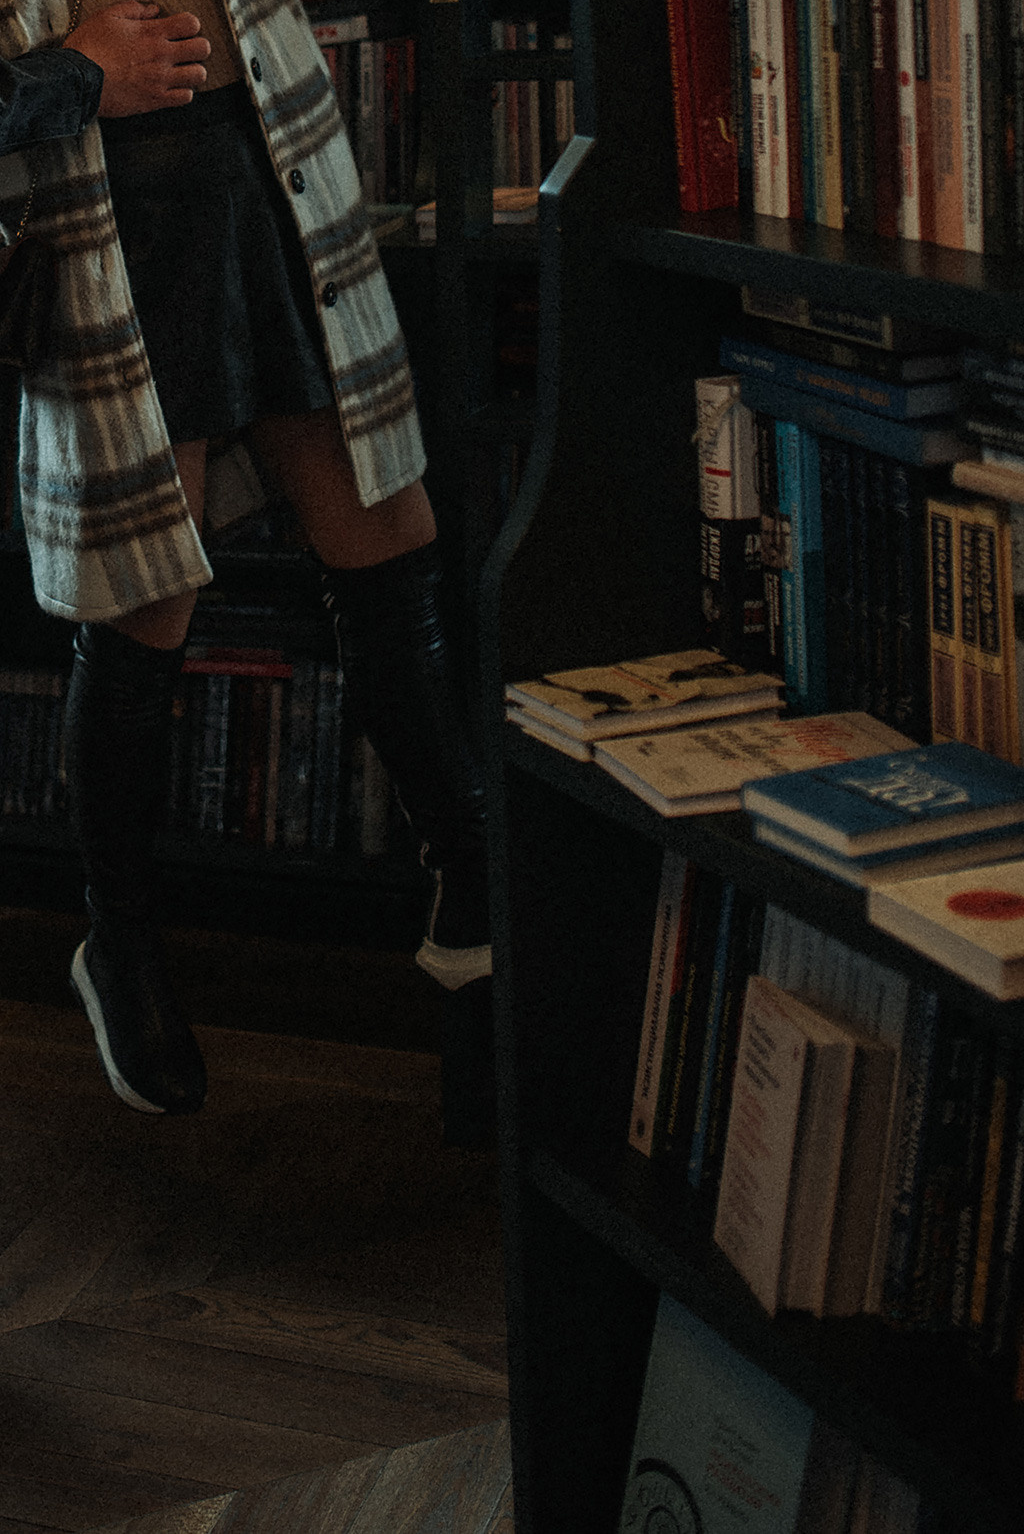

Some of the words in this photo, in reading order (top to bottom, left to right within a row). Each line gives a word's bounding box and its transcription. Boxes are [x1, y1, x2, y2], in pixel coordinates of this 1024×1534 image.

[936, 519, 948, 589] ФРОММ
[963, 528, 973, 598] ФРОММ
[978, 531, 994, 615] ФРОММ
